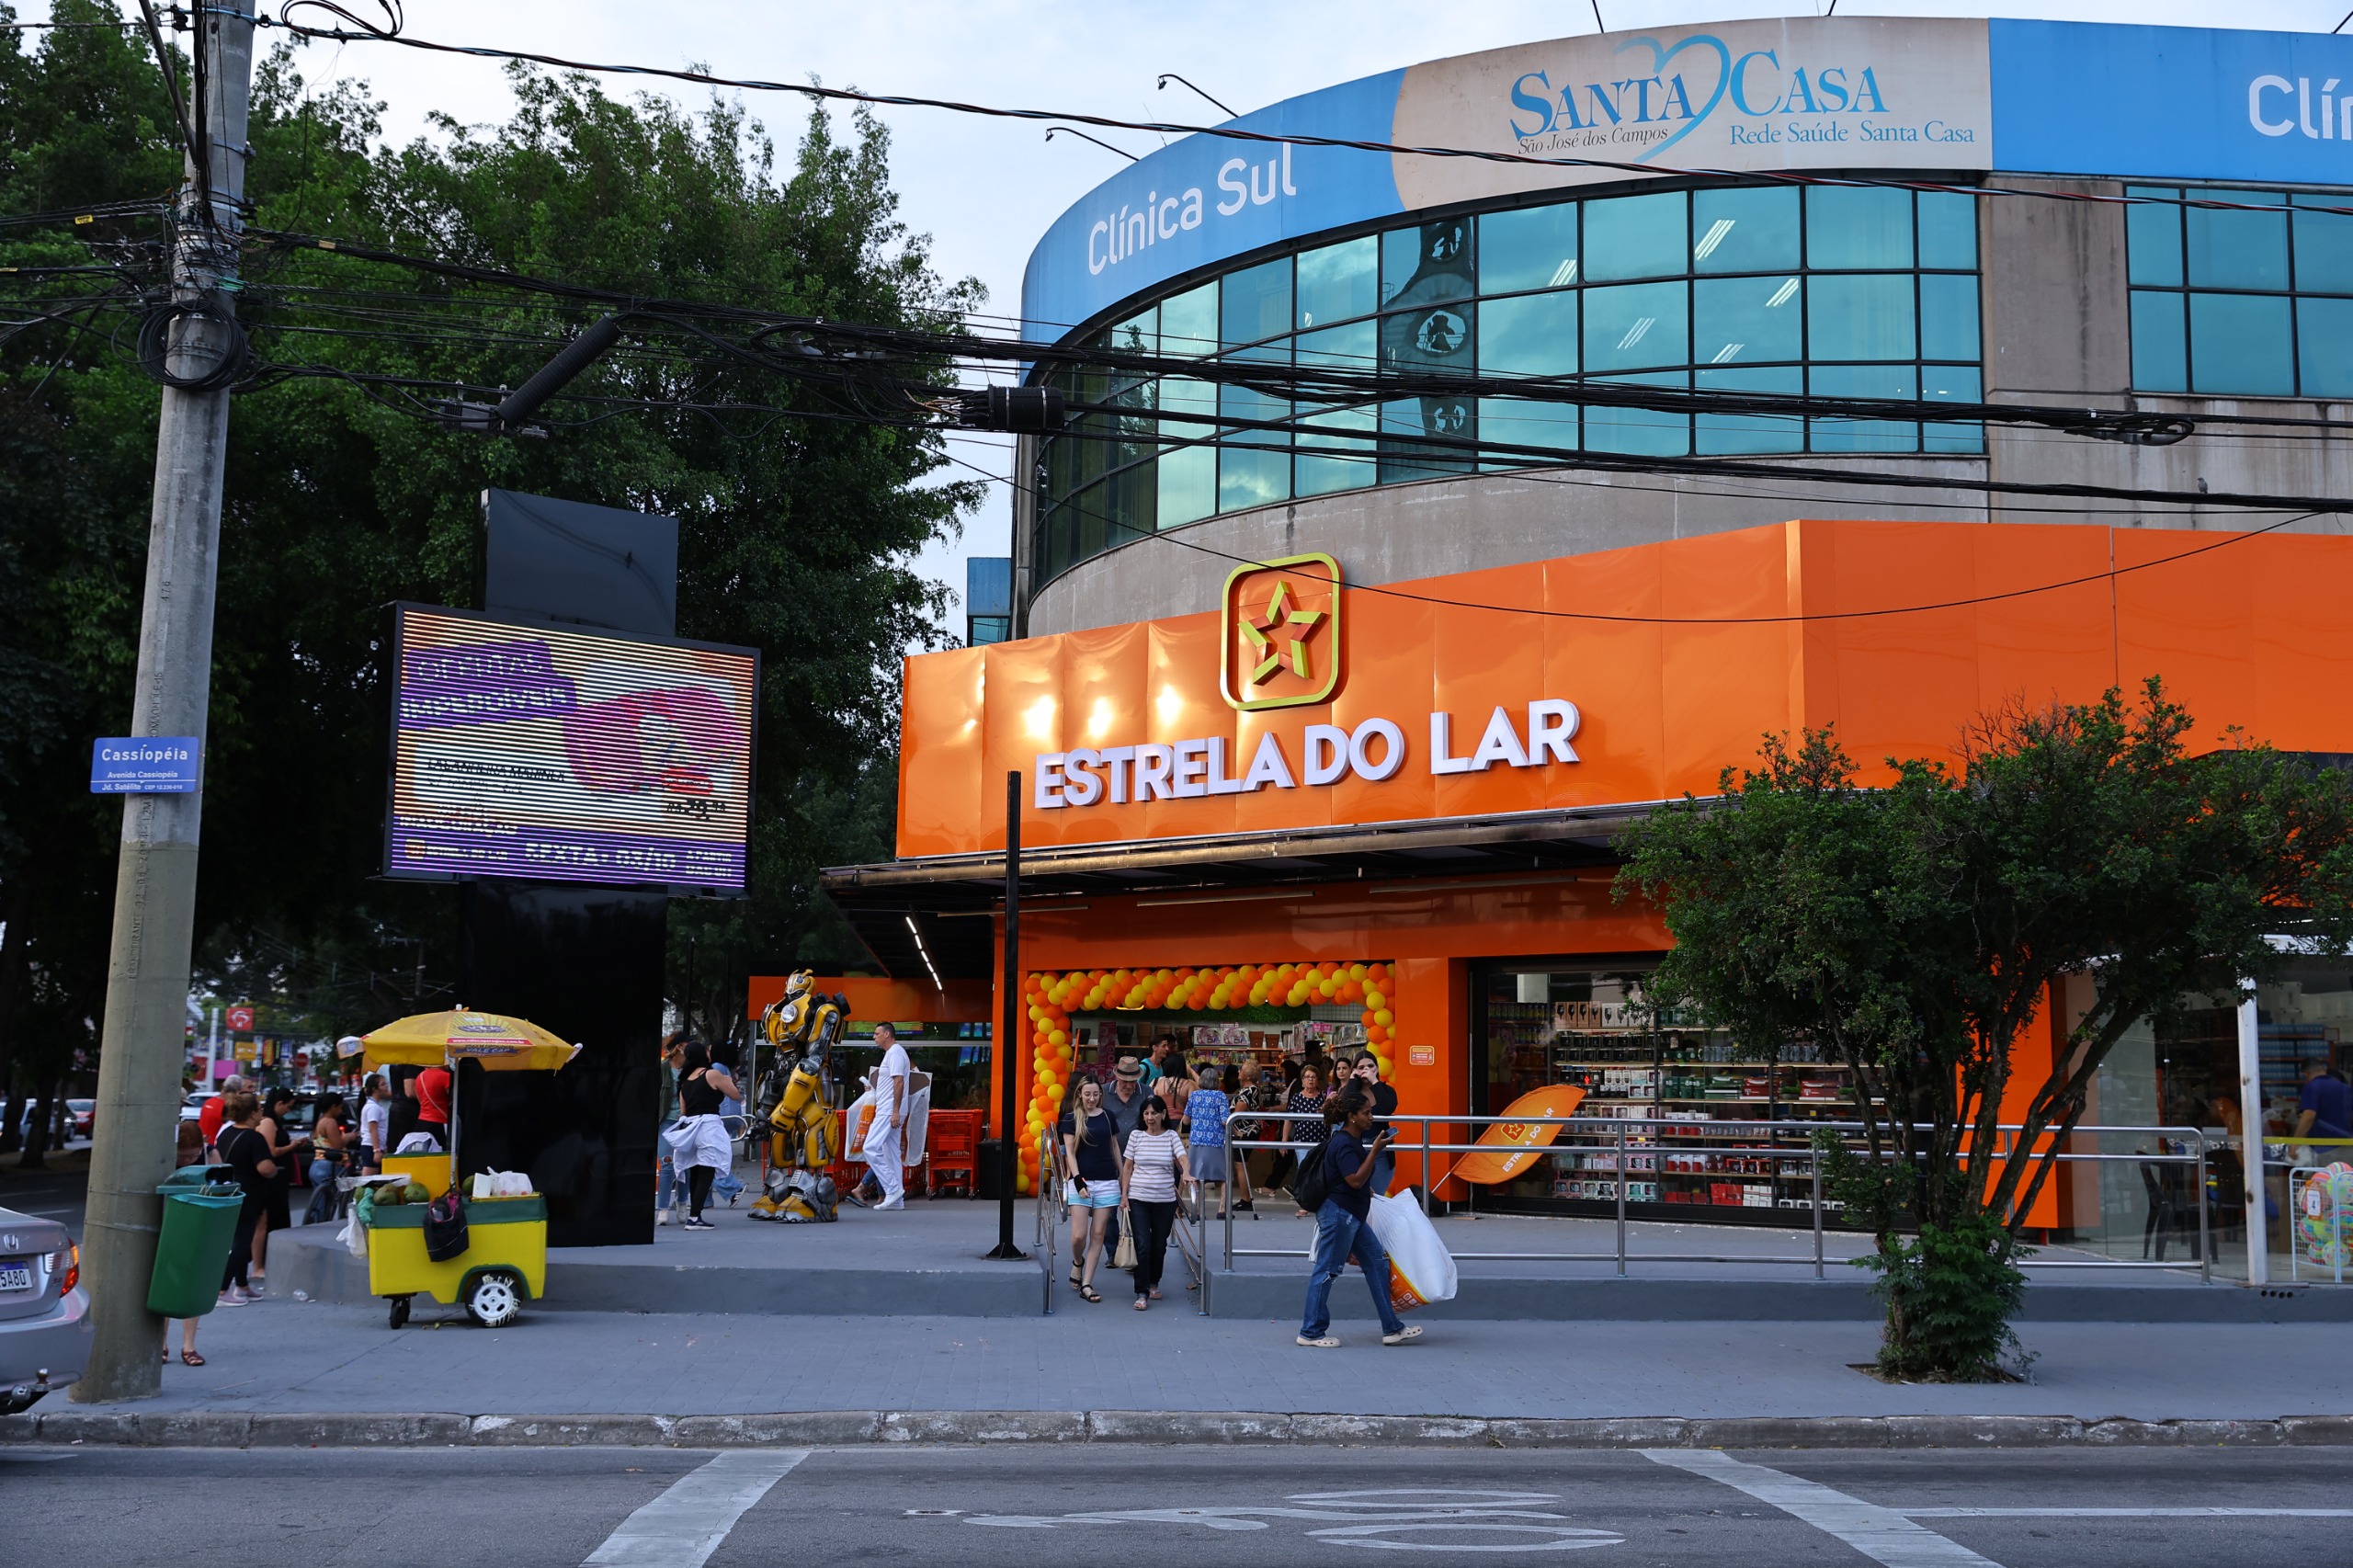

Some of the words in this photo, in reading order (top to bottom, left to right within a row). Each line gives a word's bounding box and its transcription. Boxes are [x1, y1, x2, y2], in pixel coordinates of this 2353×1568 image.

[1510, 70, 1696, 142] SANTA
[1730, 49, 1890, 117] CASA
[1518, 138, 1543, 154] São
[1547, 132, 1579, 151] José
[1583, 131, 1607, 146] dos
[1611, 127, 1668, 145] Campos
[1730, 122, 1781, 145] Rede
[1788, 121, 1848, 142] Saúde
[1859, 120, 1919, 142] Santa
[1924, 120, 1975, 142] Casa
[1088, 187, 1203, 276] Clínica
[1216, 142, 1297, 216] Sul
[101, 746, 188, 764] Cassiopéia
[1035, 731, 1295, 809] ESTRELA
[1304, 718, 1405, 786] DO
[1430, 698, 1581, 775] LAR
[114, 782, 142, 790] Satélite
[137, 770, 178, 779] Cassiopéia
[1502, 1140, 1532, 1172] ESTRA
[1529, 1125, 1541, 1139] DO
[0, 1270, 27, 1287] 5A80
